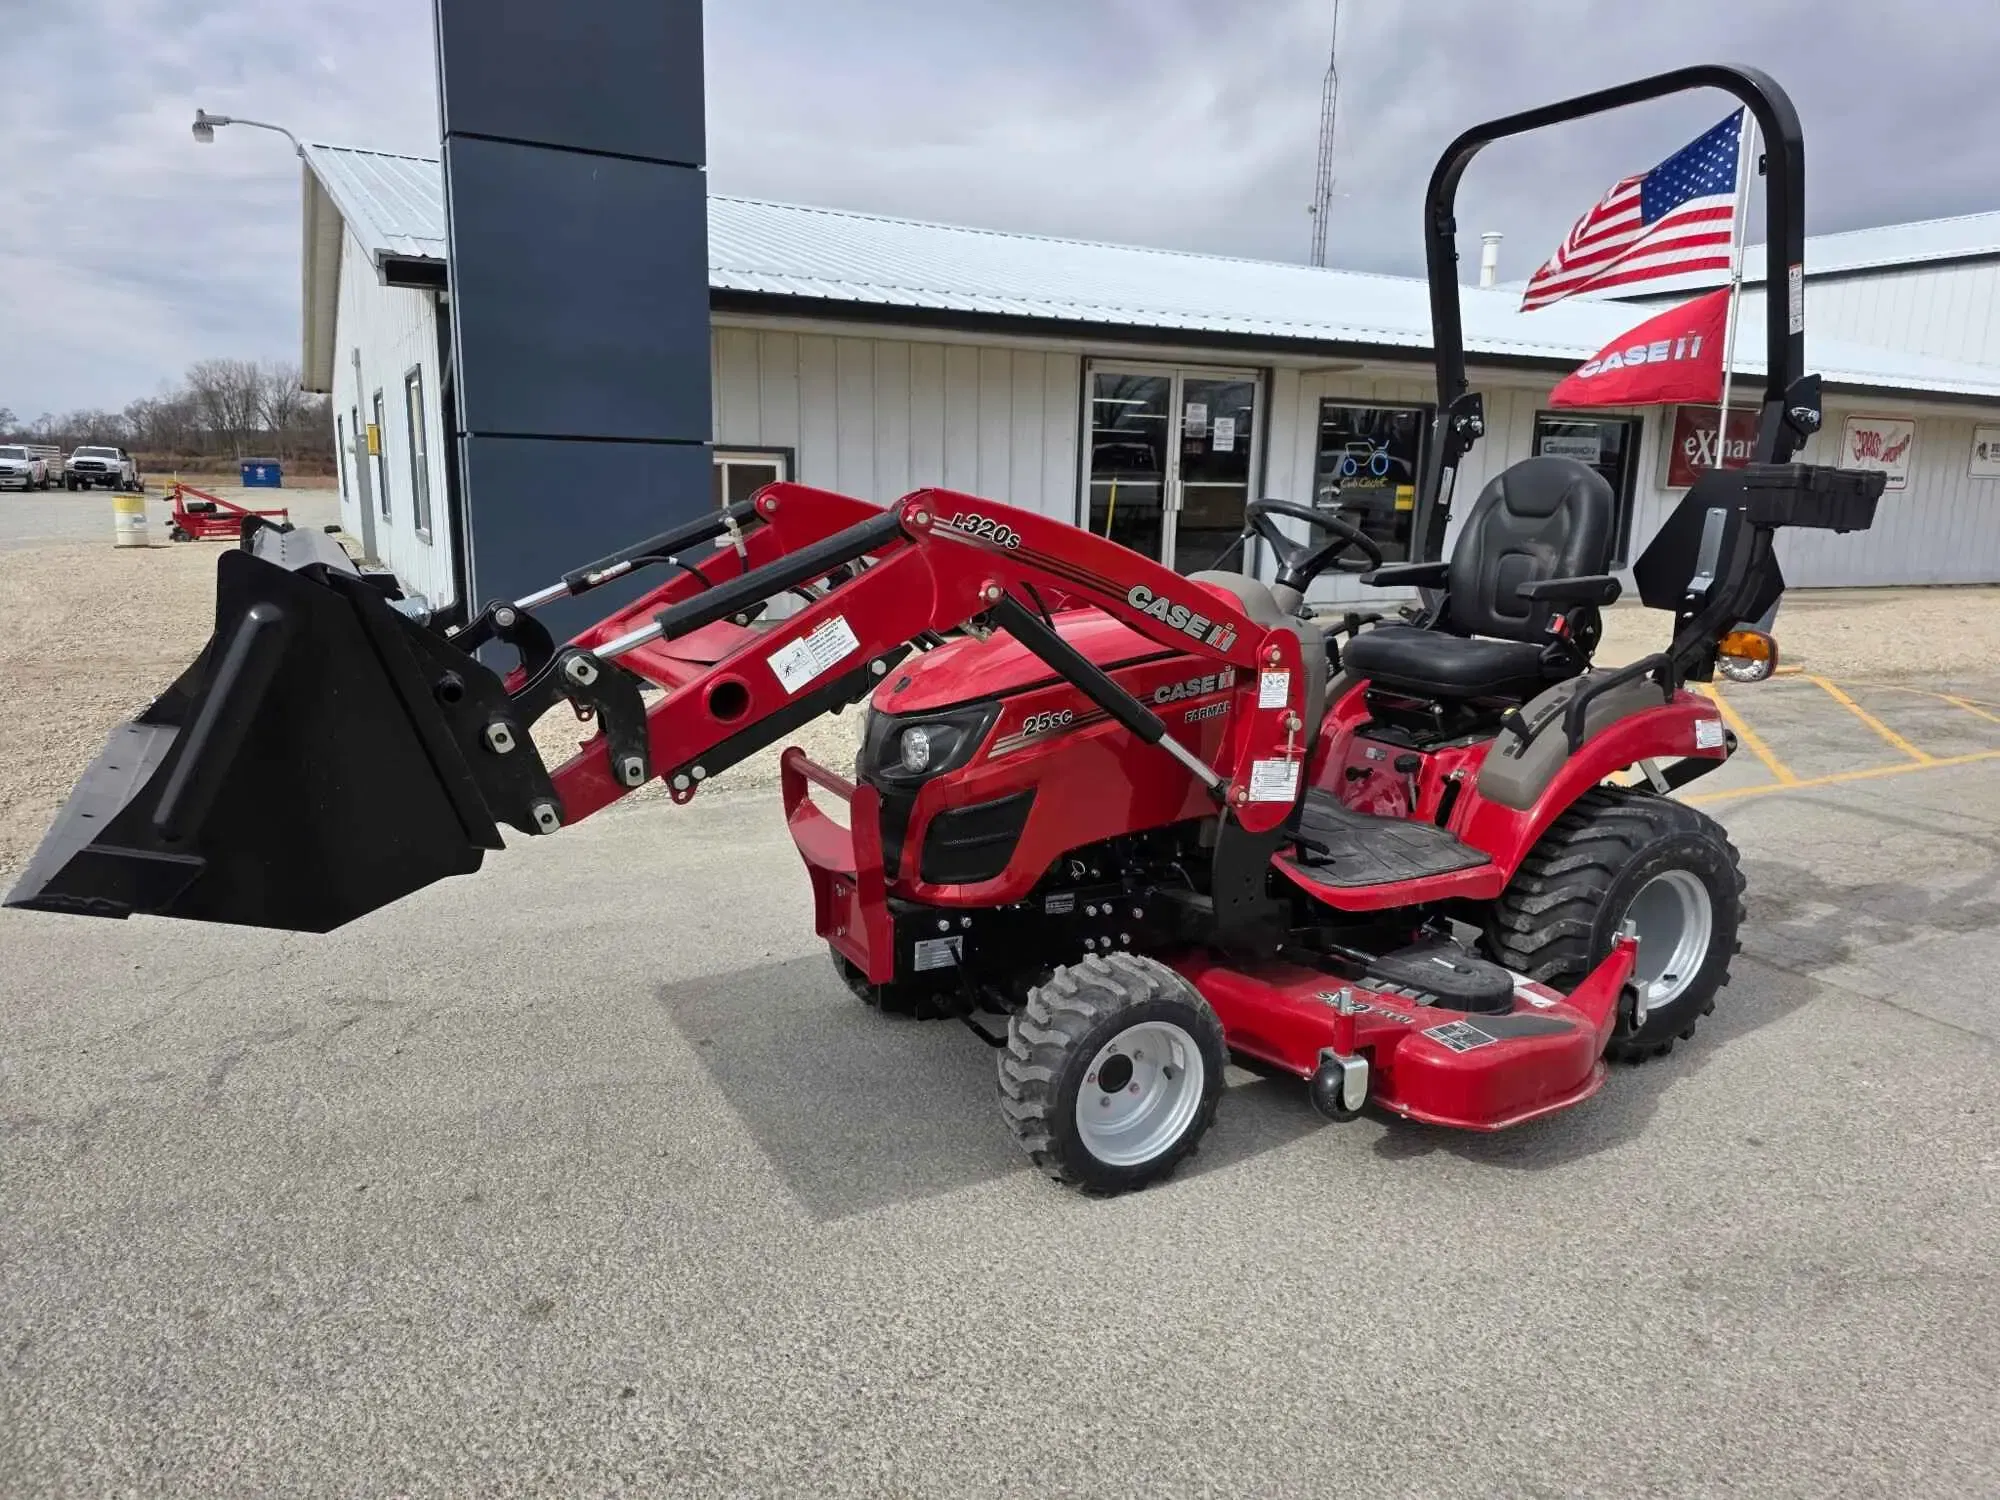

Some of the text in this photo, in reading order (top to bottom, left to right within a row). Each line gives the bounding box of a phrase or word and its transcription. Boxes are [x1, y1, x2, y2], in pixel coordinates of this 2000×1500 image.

[1577, 340, 1671, 378] CASE
[1128, 585, 1211, 639] CASE
[1154, 675, 1215, 703] CASE
